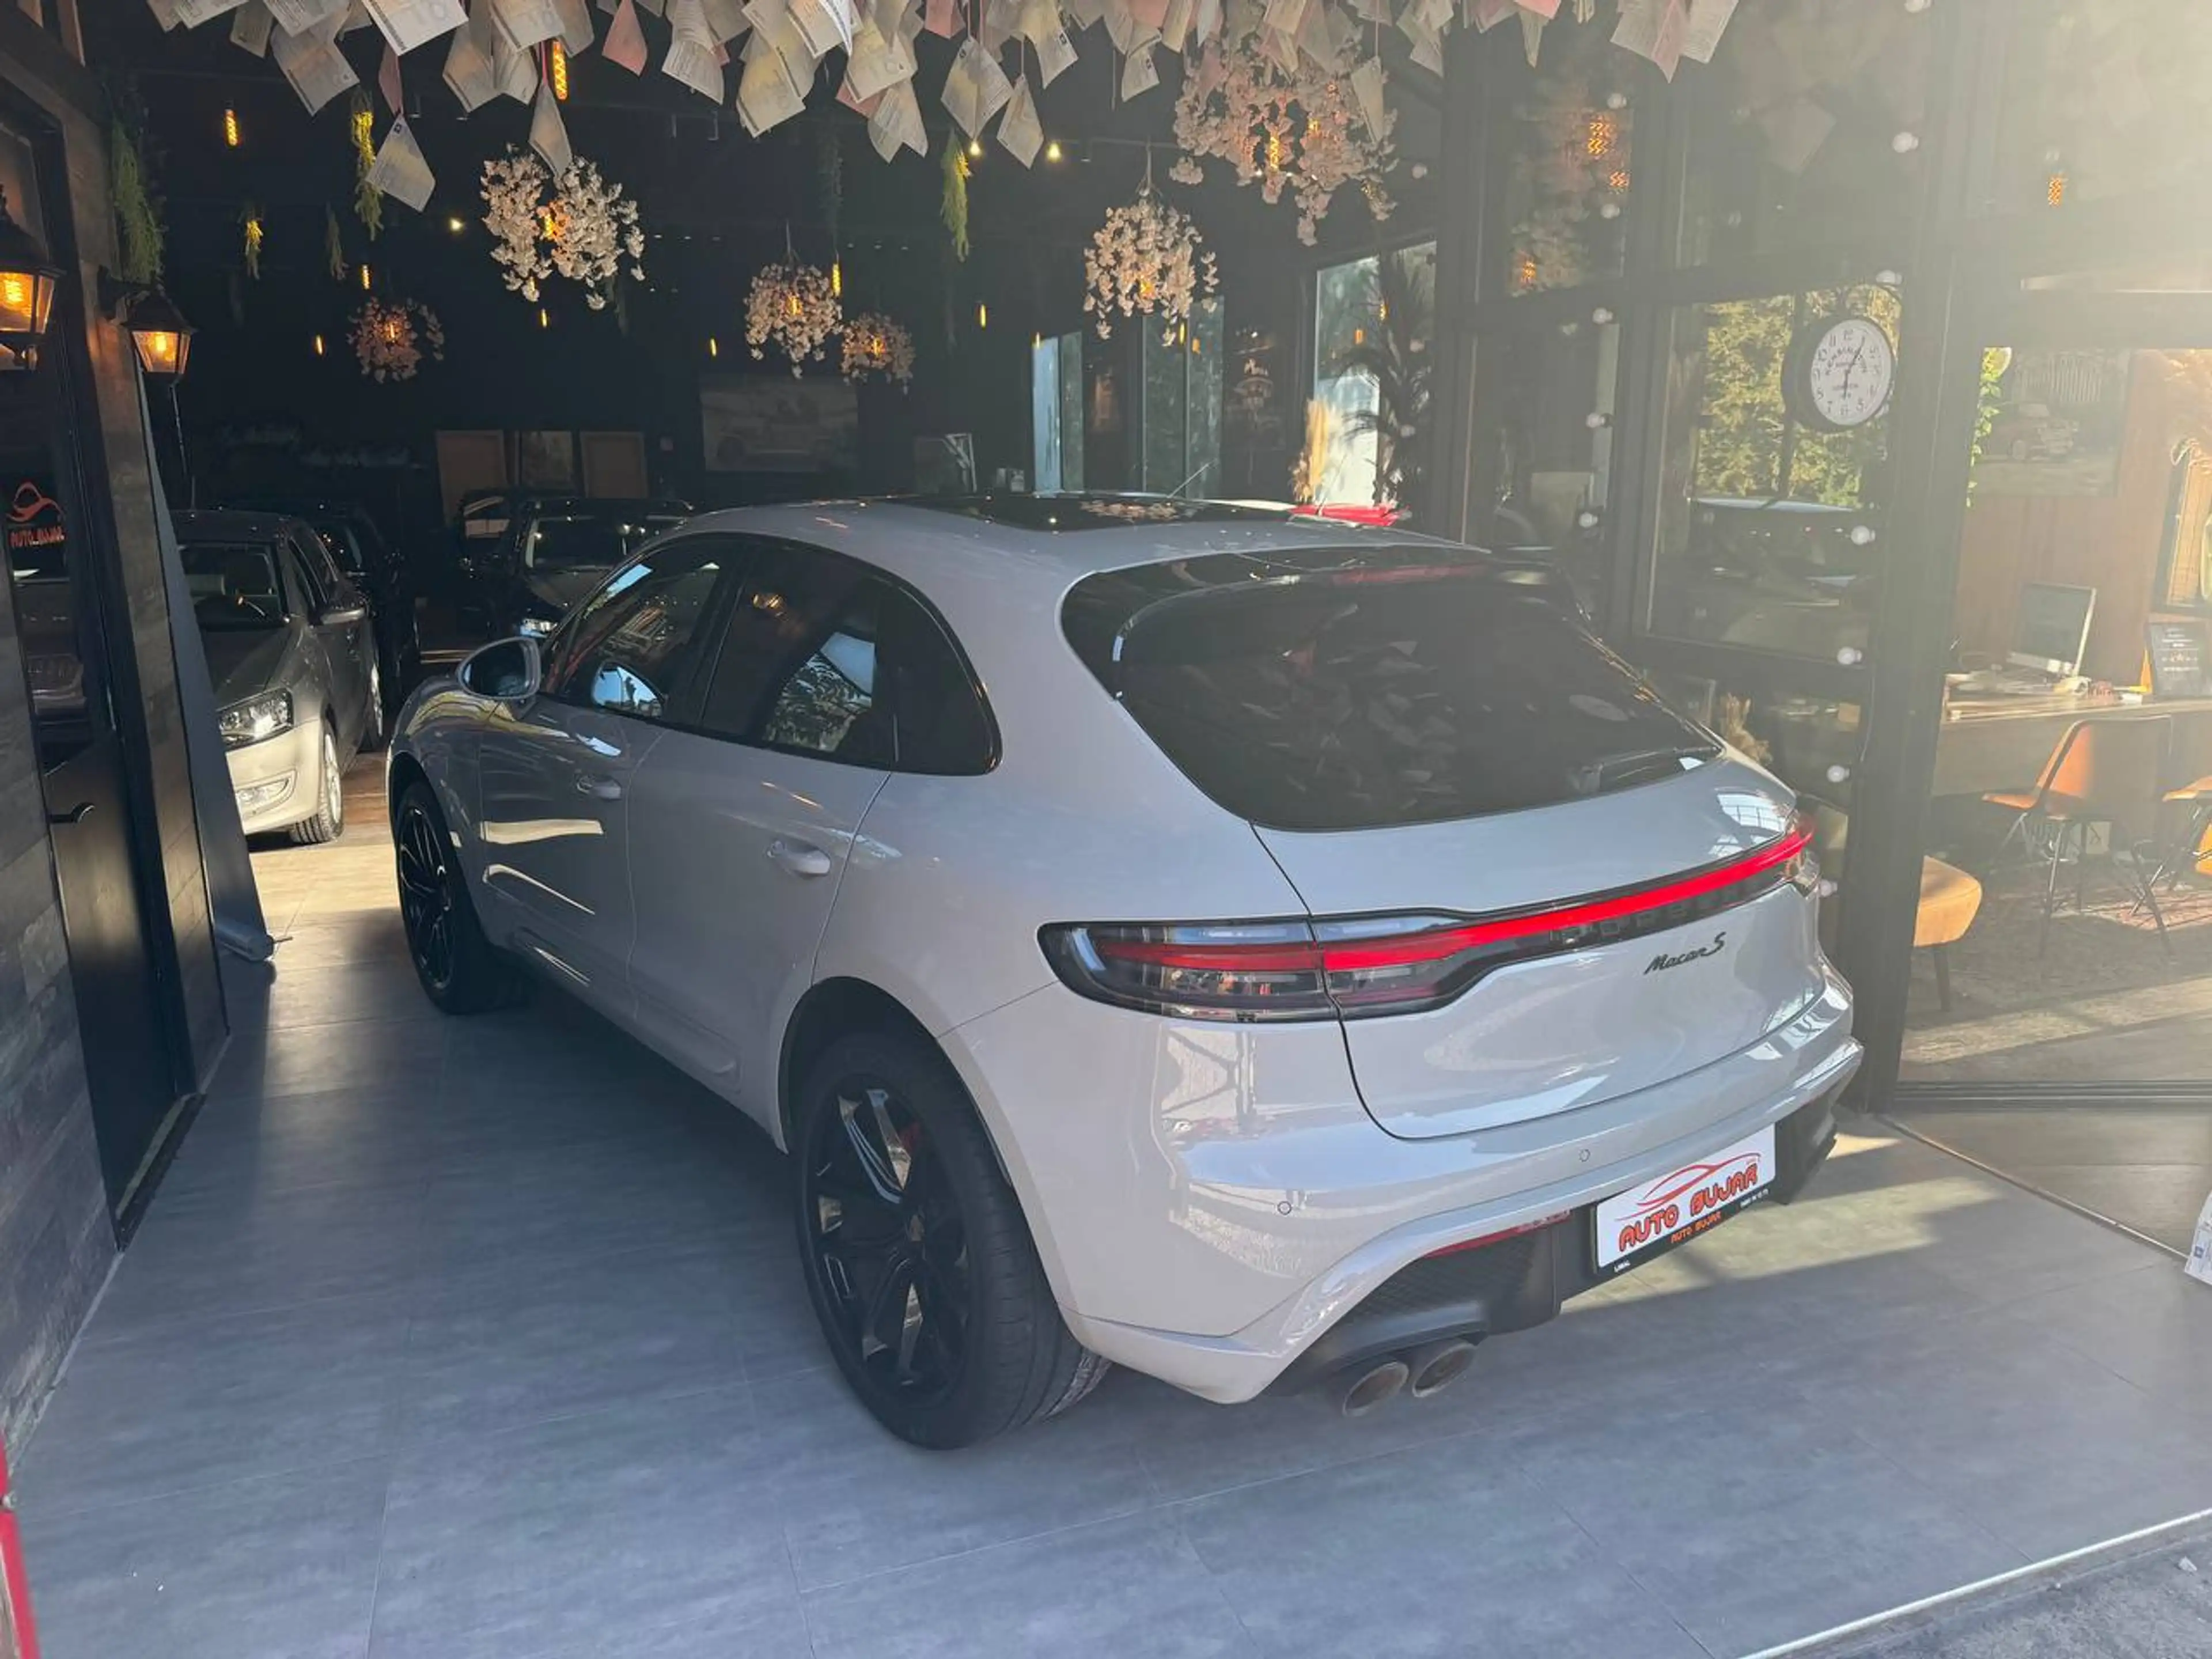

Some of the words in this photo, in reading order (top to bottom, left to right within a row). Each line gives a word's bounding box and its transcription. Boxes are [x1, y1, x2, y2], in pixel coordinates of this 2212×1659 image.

[1619, 1205, 1679, 1252] AUTO
[1690, 1163, 1758, 1216] BUJAR
[1671, 1227, 1693, 1244] AUTO
